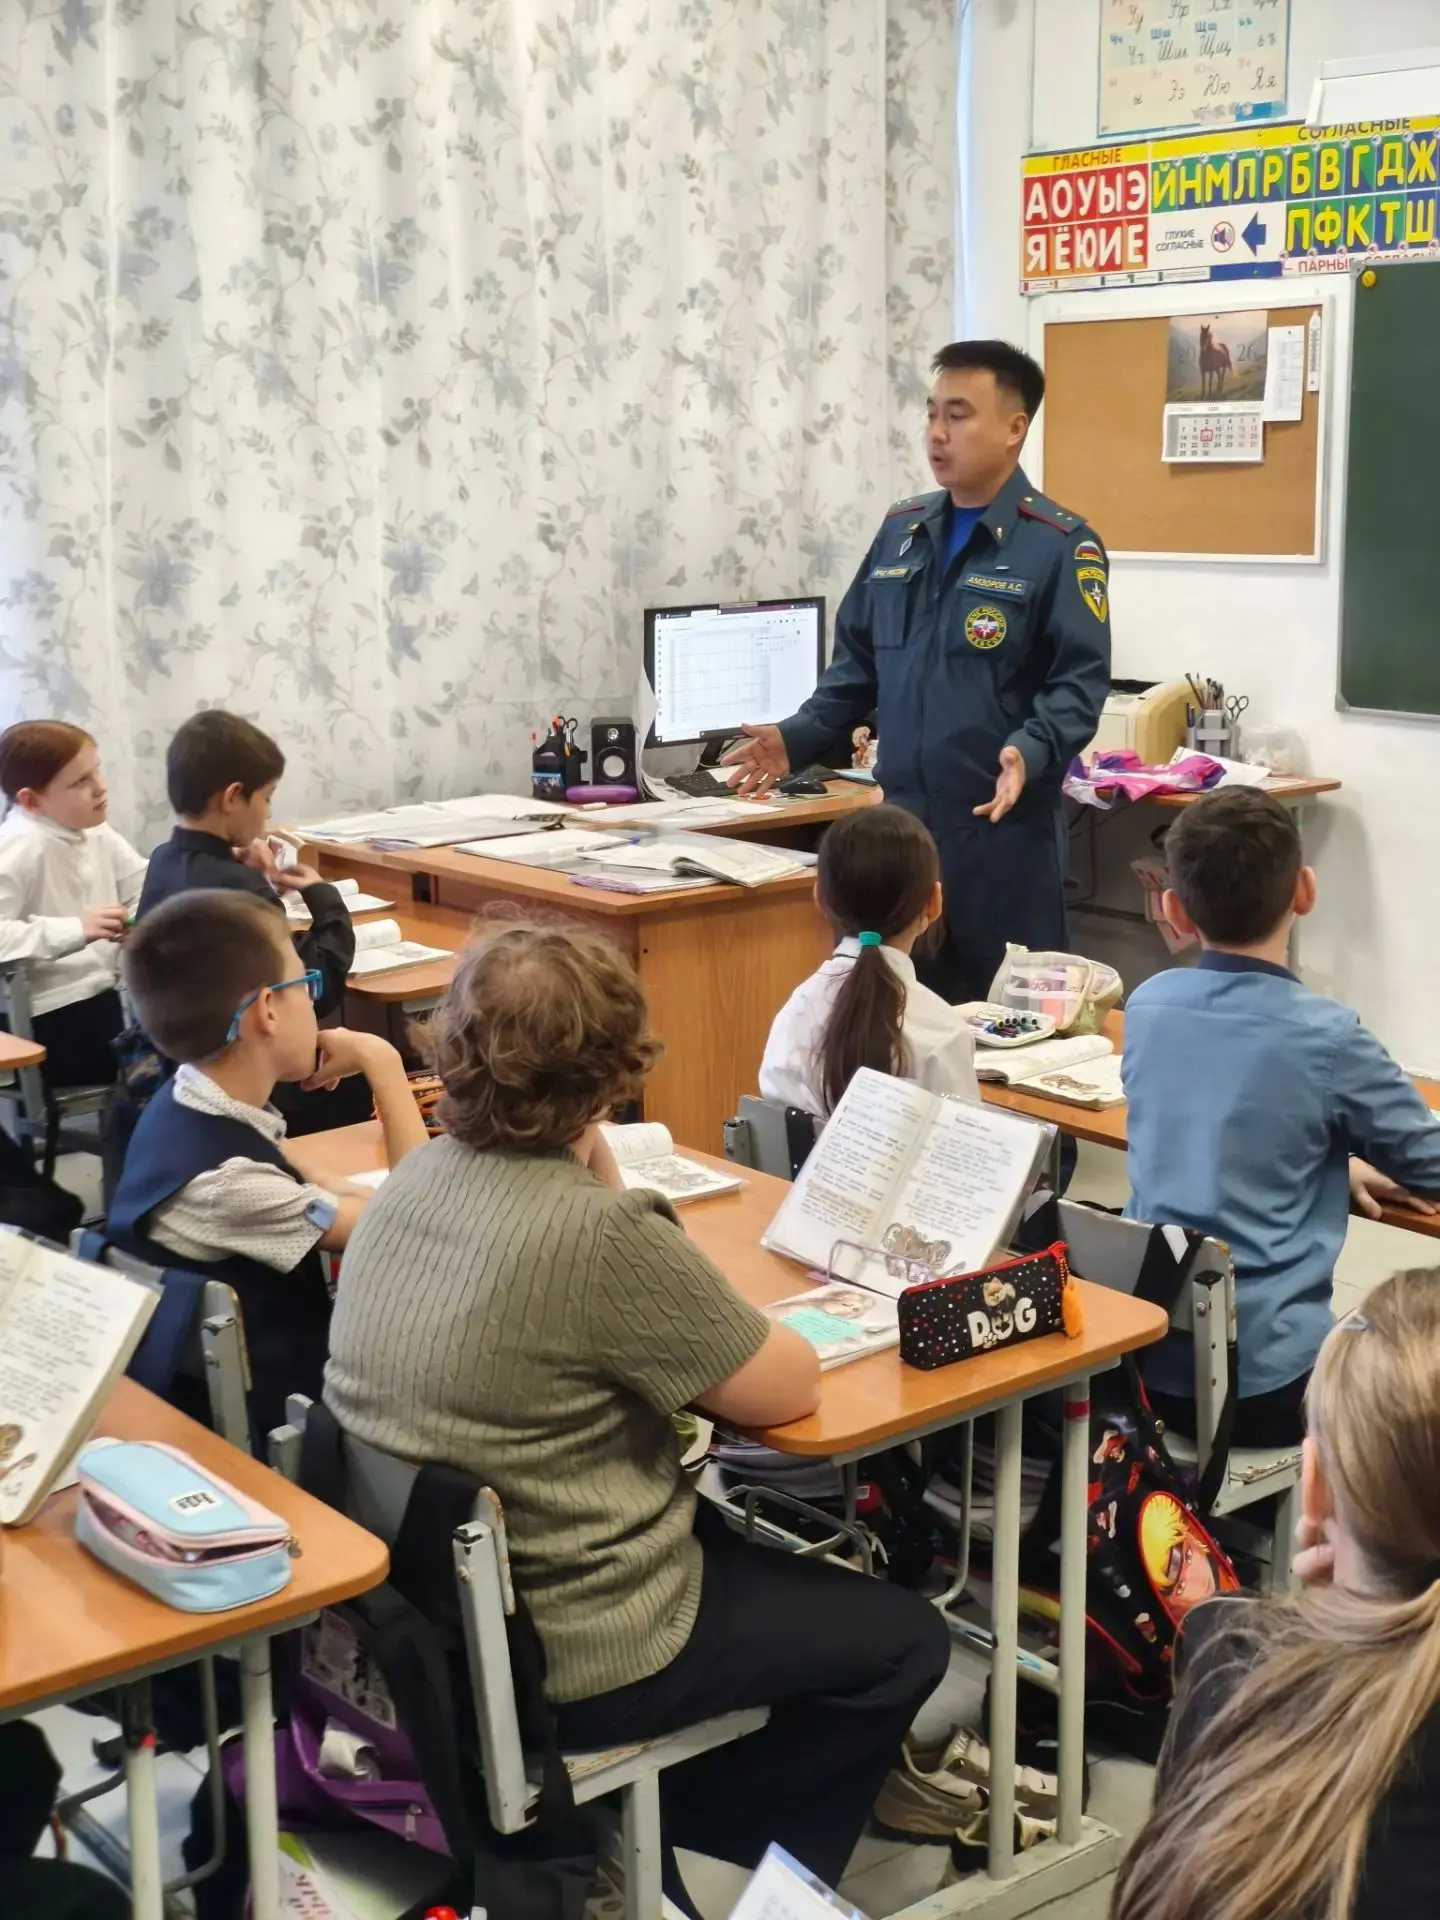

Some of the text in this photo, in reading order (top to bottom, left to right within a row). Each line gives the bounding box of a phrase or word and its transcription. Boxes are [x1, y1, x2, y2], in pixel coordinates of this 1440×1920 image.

[1052, 148, 1122, 171] ГЛАСНЫЕ
[1165, 228, 1195, 241] ГЛУХИЕ
[1155, 239, 1205, 252] СОГЛАСНЫЕ
[967, 1297, 1037, 1348] DOG
